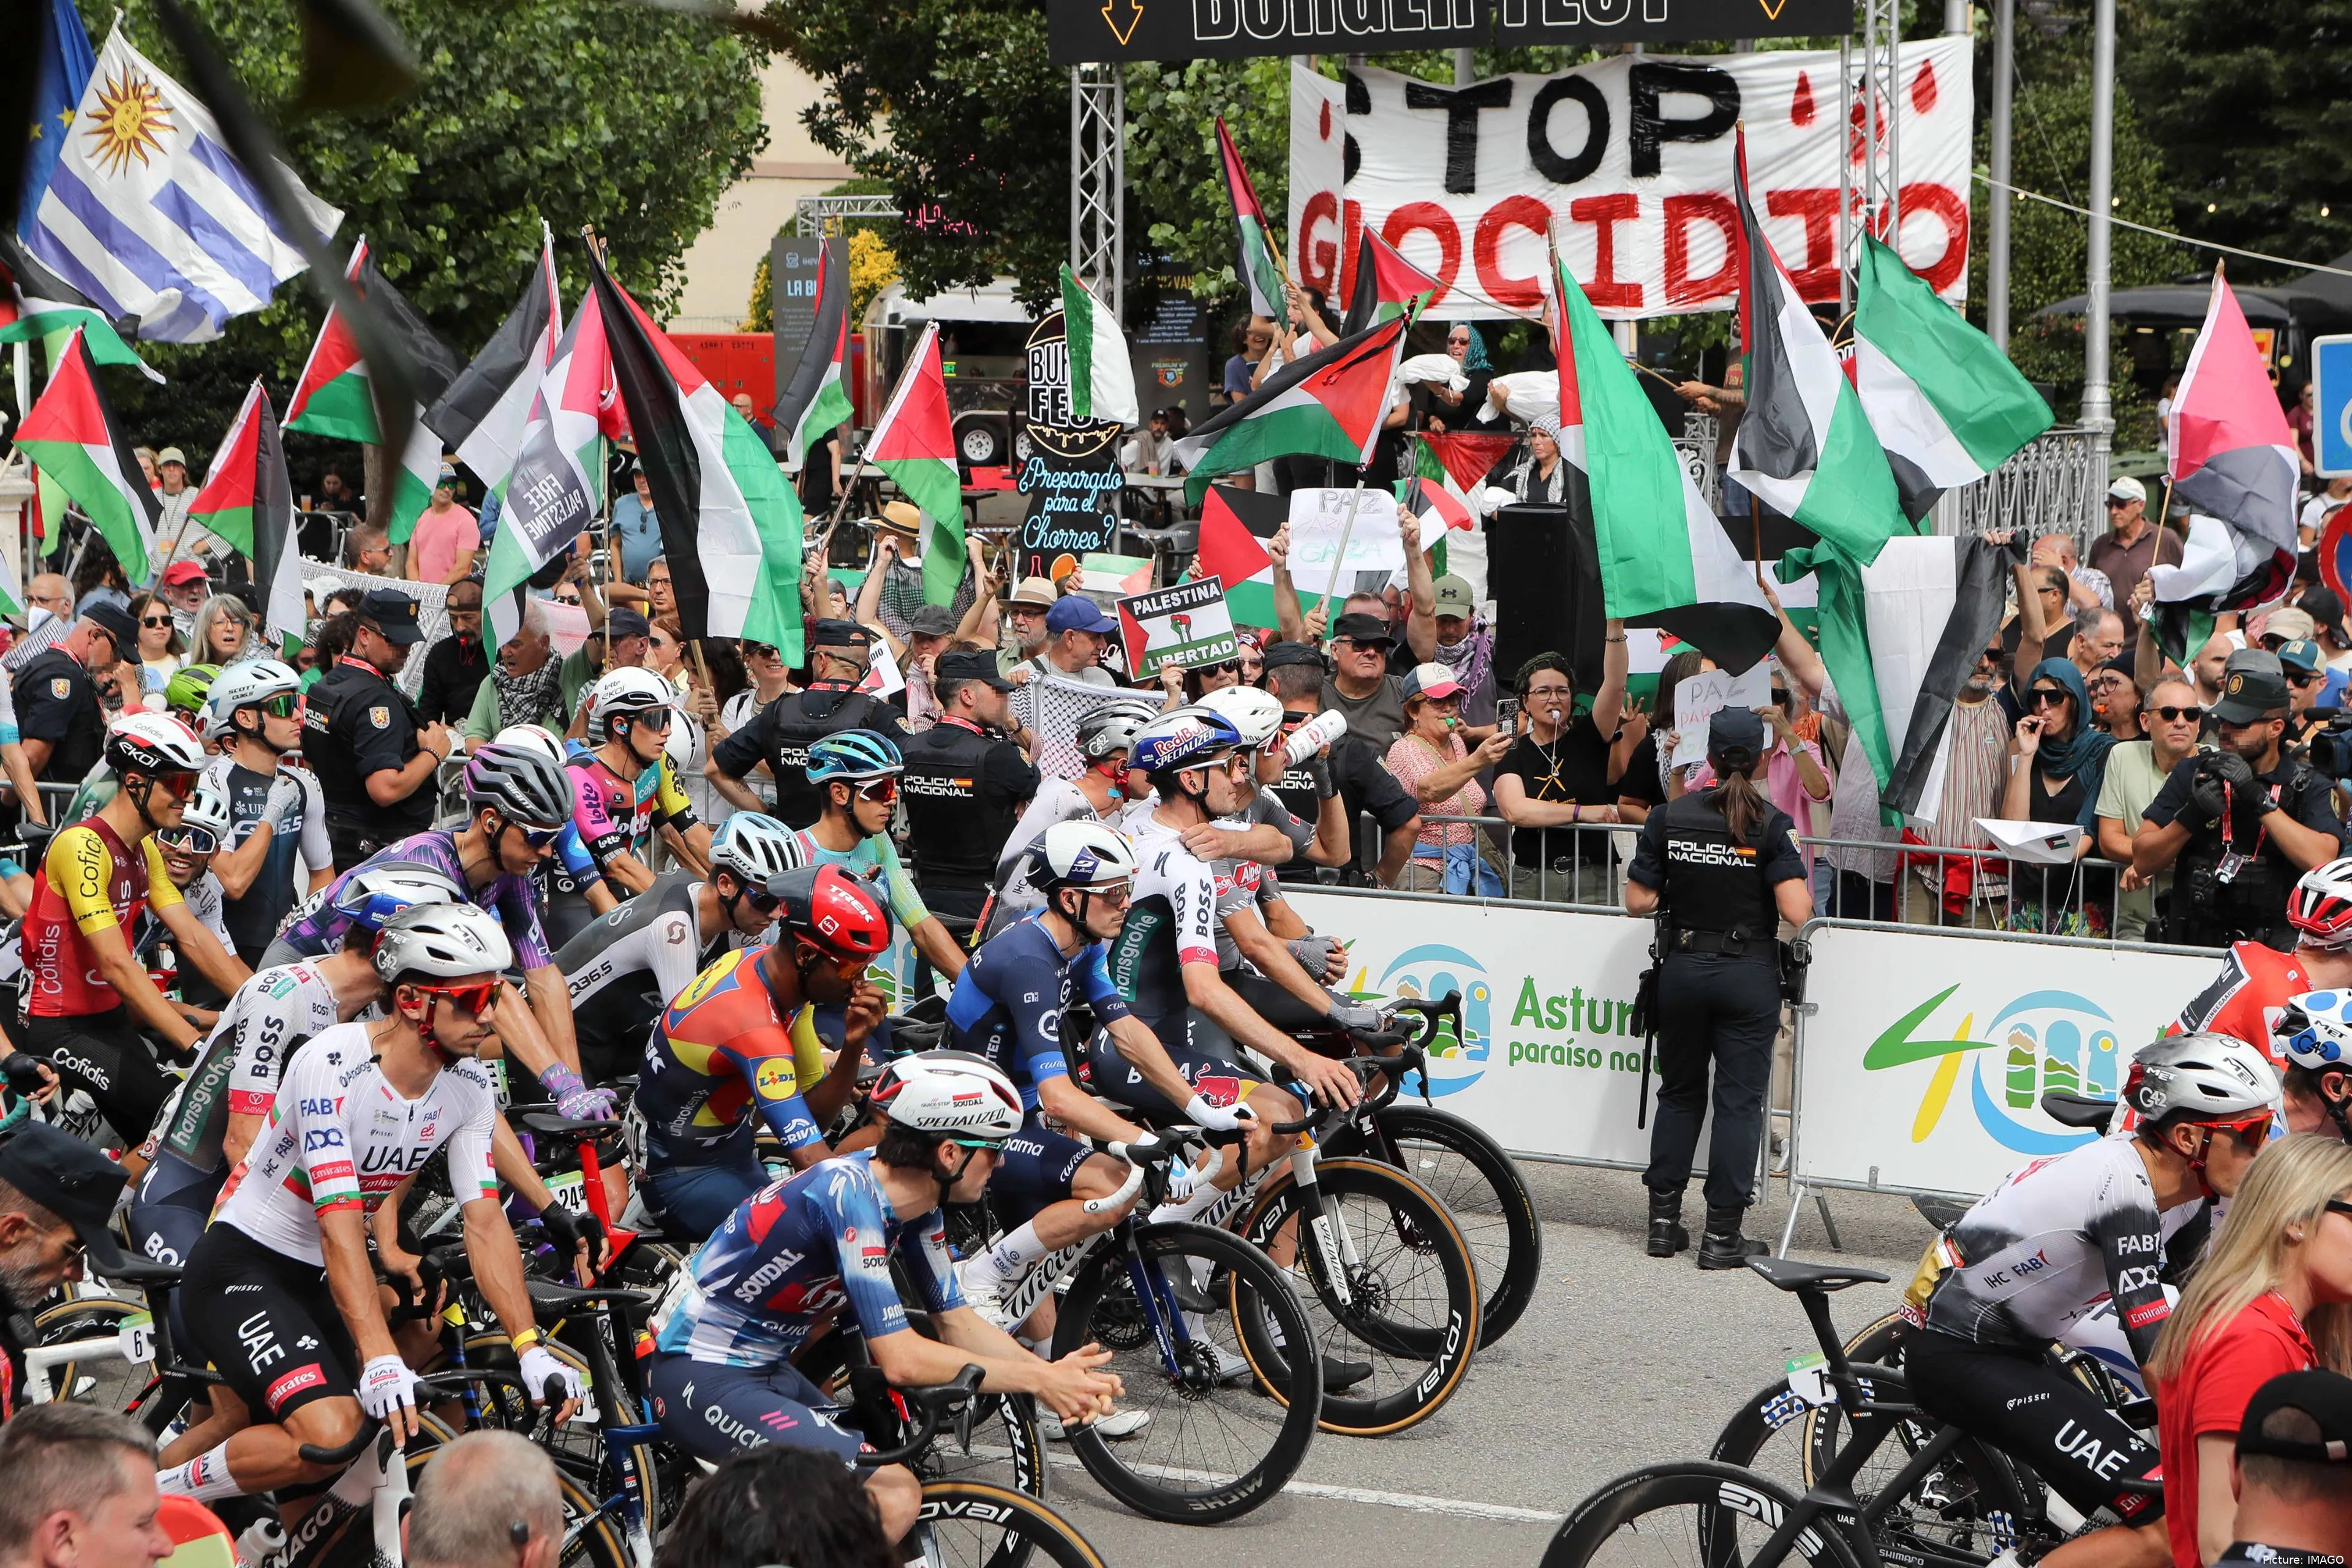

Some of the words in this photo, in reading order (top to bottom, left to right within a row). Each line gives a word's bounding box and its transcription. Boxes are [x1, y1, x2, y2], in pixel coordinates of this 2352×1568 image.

[1042, 495, 1079, 518] para
[1081, 489, 1096, 513] el
[1133, 581, 1223, 616] PALESTINA
[1147, 639, 1234, 672] LIBERTAD
[1155, 727, 1216, 770] SPECIALIZED
[639, 775, 657, 799] caps
[904, 775, 957, 788] POLICIA
[904, 785, 974, 797] NACIONAL
[504, 782, 537, 811] GIANT
[725, 847, 754, 872] SCOTT
[1668, 840, 1738, 856] POLICIA
[1668, 851, 1756, 867] NACIONAL
[1071, 866, 1094, 875] Julbo
[830, 884, 875, 924] TREK
[1174, 881, 1186, 938] BORA
[1196, 878, 1213, 938] BOSS
[385, 930, 410, 944] MET
[452, 924, 487, 954] MET
[41, 924, 62, 995] Cofidis
[1115, 914, 1158, 998] hansgrohe
[568, 960, 613, 998] Q36.5
[2206, 987, 2236, 1023] VINGEGAARD
[2313, 1019, 2348, 1039] MET
[251, 1015, 284, 1078] BOSS
[1509, 1038, 1602, 1069] paraíso
[2297, 1035, 2329, 1058] G42
[53, 1046, 110, 1091] Cofidis
[345, 1060, 372, 1084] Analog
[450, 1065, 488, 1089] Analog
[2146, 1066, 2178, 1082] MET
[2223, 1057, 2260, 1088] MET
[953, 1099, 984, 1108] SOUDAL
[2139, 1087, 2168, 1110] G42
[669, 1093, 701, 1137] unbroken
[913, 1107, 1006, 1128] SPECIALIZED
[779, 1123, 820, 1146] CRIVIT
[262, 1158, 279, 1178] IHC
[311, 1165, 352, 1180] Emirates
[361, 1146, 429, 1173] UAE
[1319, 1220, 1345, 1290] SPECIALIZED
[734, 1248, 805, 1303] SOUDAL
[1985, 1272, 2011, 1289] IHC
[134, 1330, 143, 1358] 6
[238, 1310, 286, 1376] UAE
[704, 1406, 770, 1449] QUICK
[2054, 1419, 2129, 1482] UAE
[916, 1500, 1014, 1525] oval
[1837, 1513, 1855, 1526] UAE
[1879, 1548, 1924, 1566] SHIMANO
